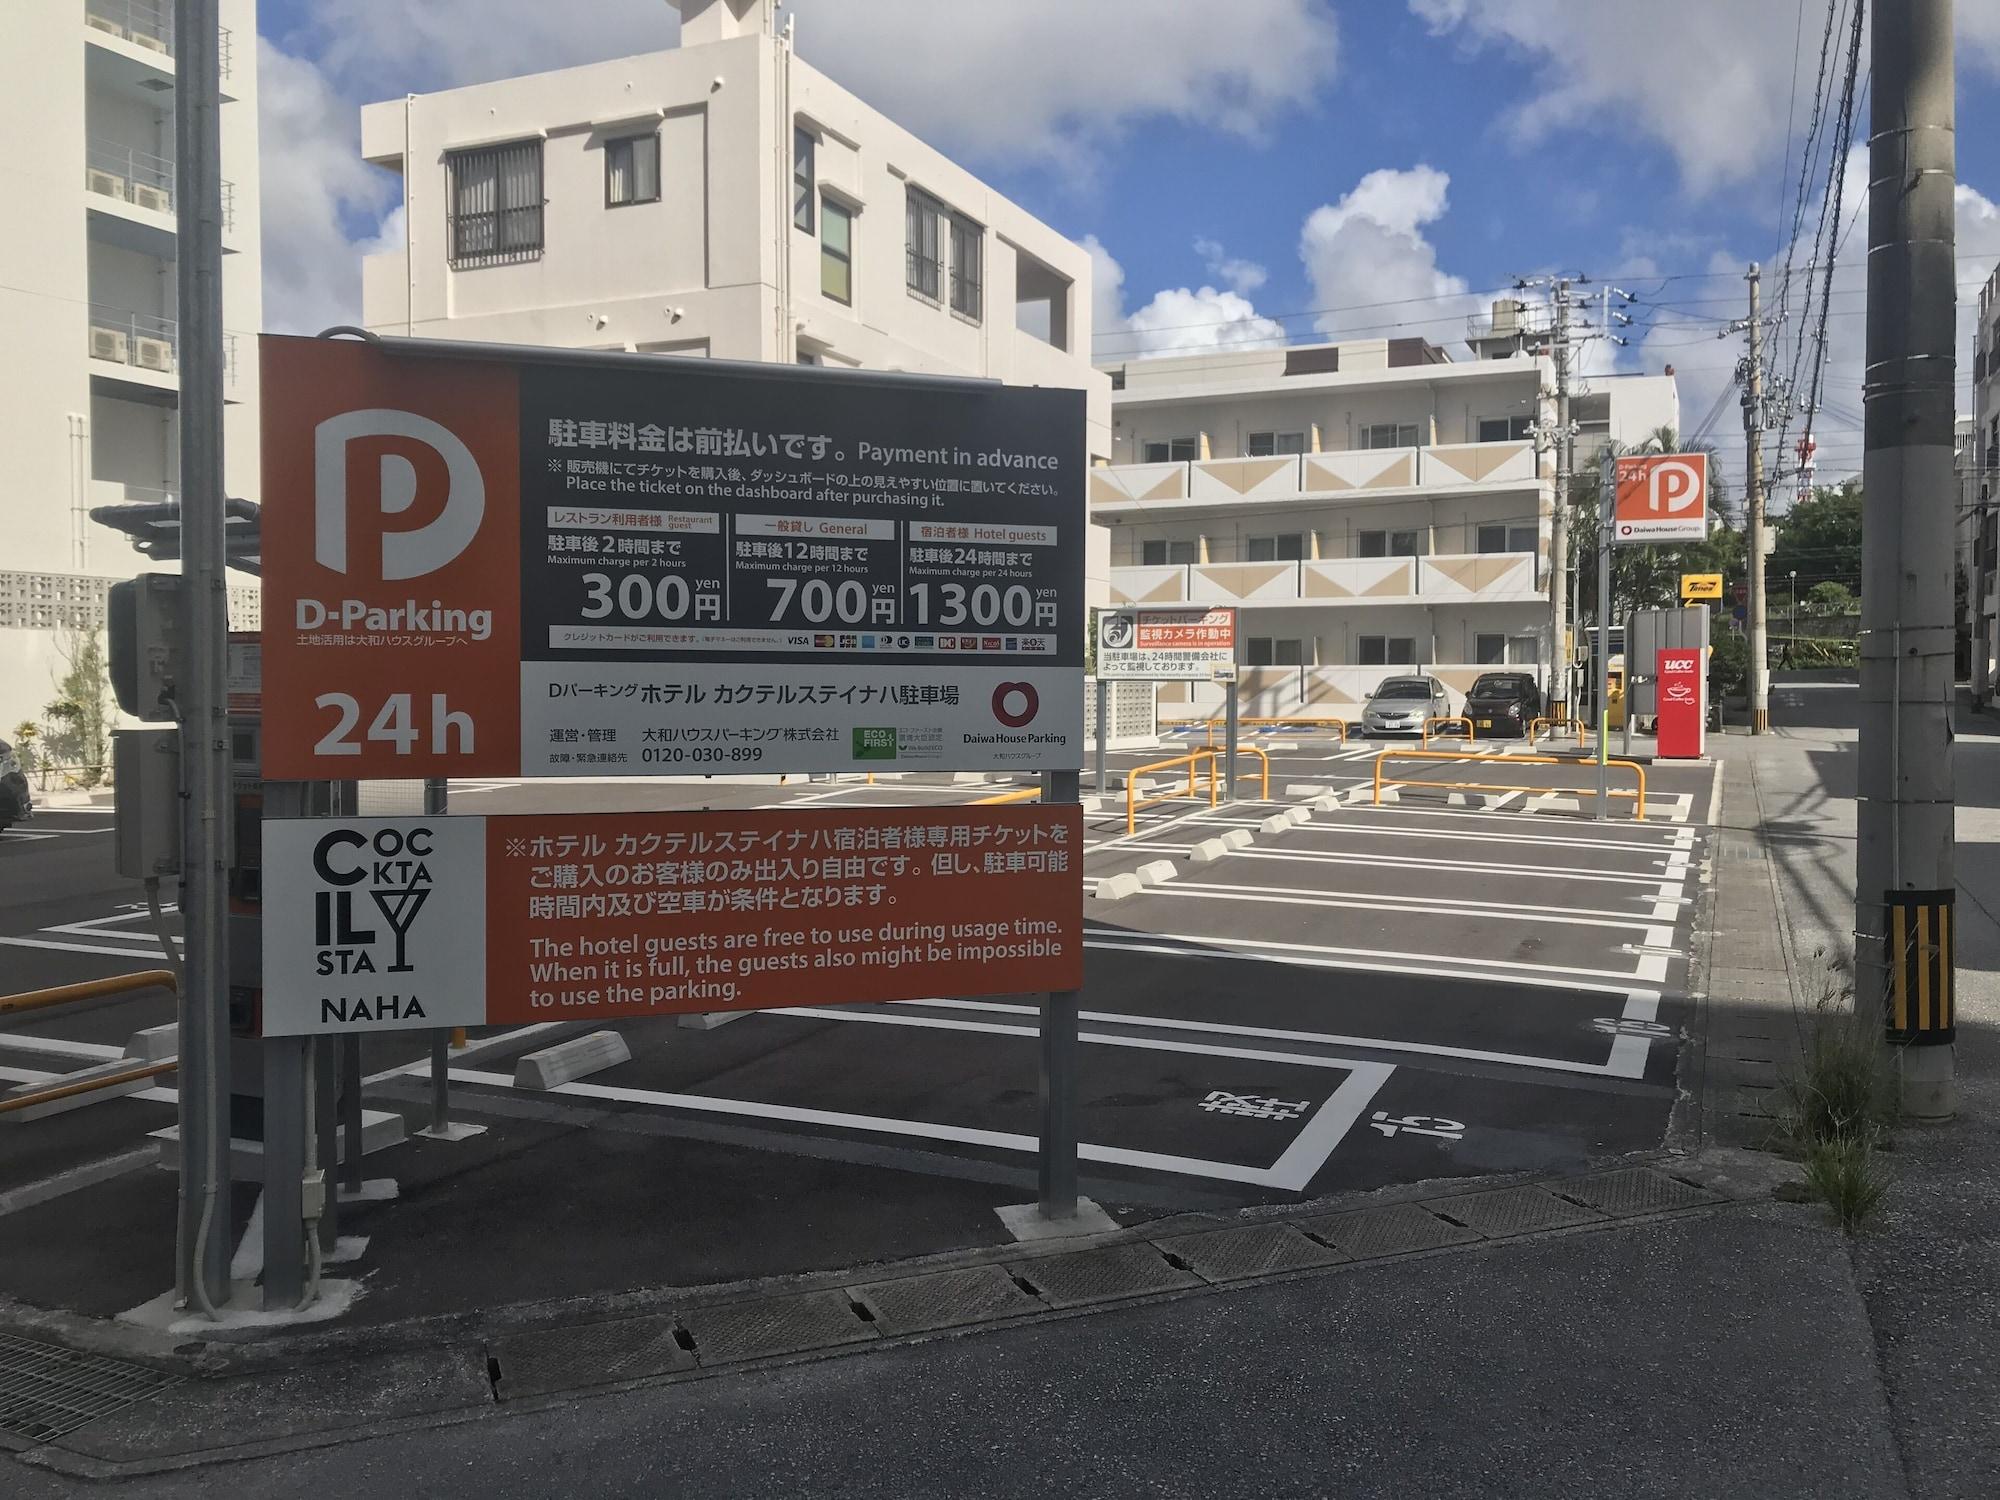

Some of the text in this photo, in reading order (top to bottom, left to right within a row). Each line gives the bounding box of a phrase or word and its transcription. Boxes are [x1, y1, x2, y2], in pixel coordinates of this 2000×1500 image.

[548, 419, 1059, 470] 駐車料金は前払いです。 Payment in advance
[566, 476, 945, 509] Place the ticket on the dashboard after purchasing it.
[554, 511, 663, 527] レストラン利用者様
[668, 514, 713, 524] Restaurant
[764, 519, 868, 535] 一般貸し General
[921, 526, 1047, 542] 宿泊者様 Hotel guests
[547, 534, 682, 555] 駐車後2時間まで
[735, 541, 869, 562] 駐車後12時間まで
[547, 555, 687, 568] Maximum charge per 2 hours
[735, 560, 869, 573] Maximum charge per 12 hours
[909, 547, 1033, 567] 駐車後24時間まで
[909, 566, 1033, 578] Maximum charge per 24 hours
[695, 578, 720, 591] yen
[872, 583, 895, 596] yen
[1036, 587, 1057, 600] yen
[581, 572, 690, 620] 300
[766, 578, 867, 624] 700
[909, 582, 1032, 627] 1300
[695, 593, 721, 621] 円
[871, 598, 895, 625] 円
[1035, 602, 1057, 627] 円
[296, 598, 492, 641] D-Parking
[296, 634, 468, 647] 土地活用は大和ハウスグループへ
[788, 636, 809, 645] VISA
[1140, 628, 1231, 640] 監視カメラ作動中
[549, 682, 960, 706] Dパーキング ホテル カクテルステイナハ駐車場
[549, 727, 840, 743] 運営・管理 大和ハウスパーキング株式会社
[864, 730, 886, 739] ECO
[864, 738, 895, 748] FIRST
[963, 733, 1066, 746] Daiwa House Parking
[642, 747, 763, 763] 0120-030-899
[615, 823, 1069, 856] カクテルステイナハ宿泊者様専用チケットを
[529, 883, 897, 919] 時間内及び空車が条件となります。
[529, 917, 1063, 958] The hotel guests are free to use during usage time.
[529, 938, 1063, 983] When it is full, the guests also might be impossible
[529, 978, 742, 1008] to use the parking.
[321, 995, 427, 1024] NAHA
